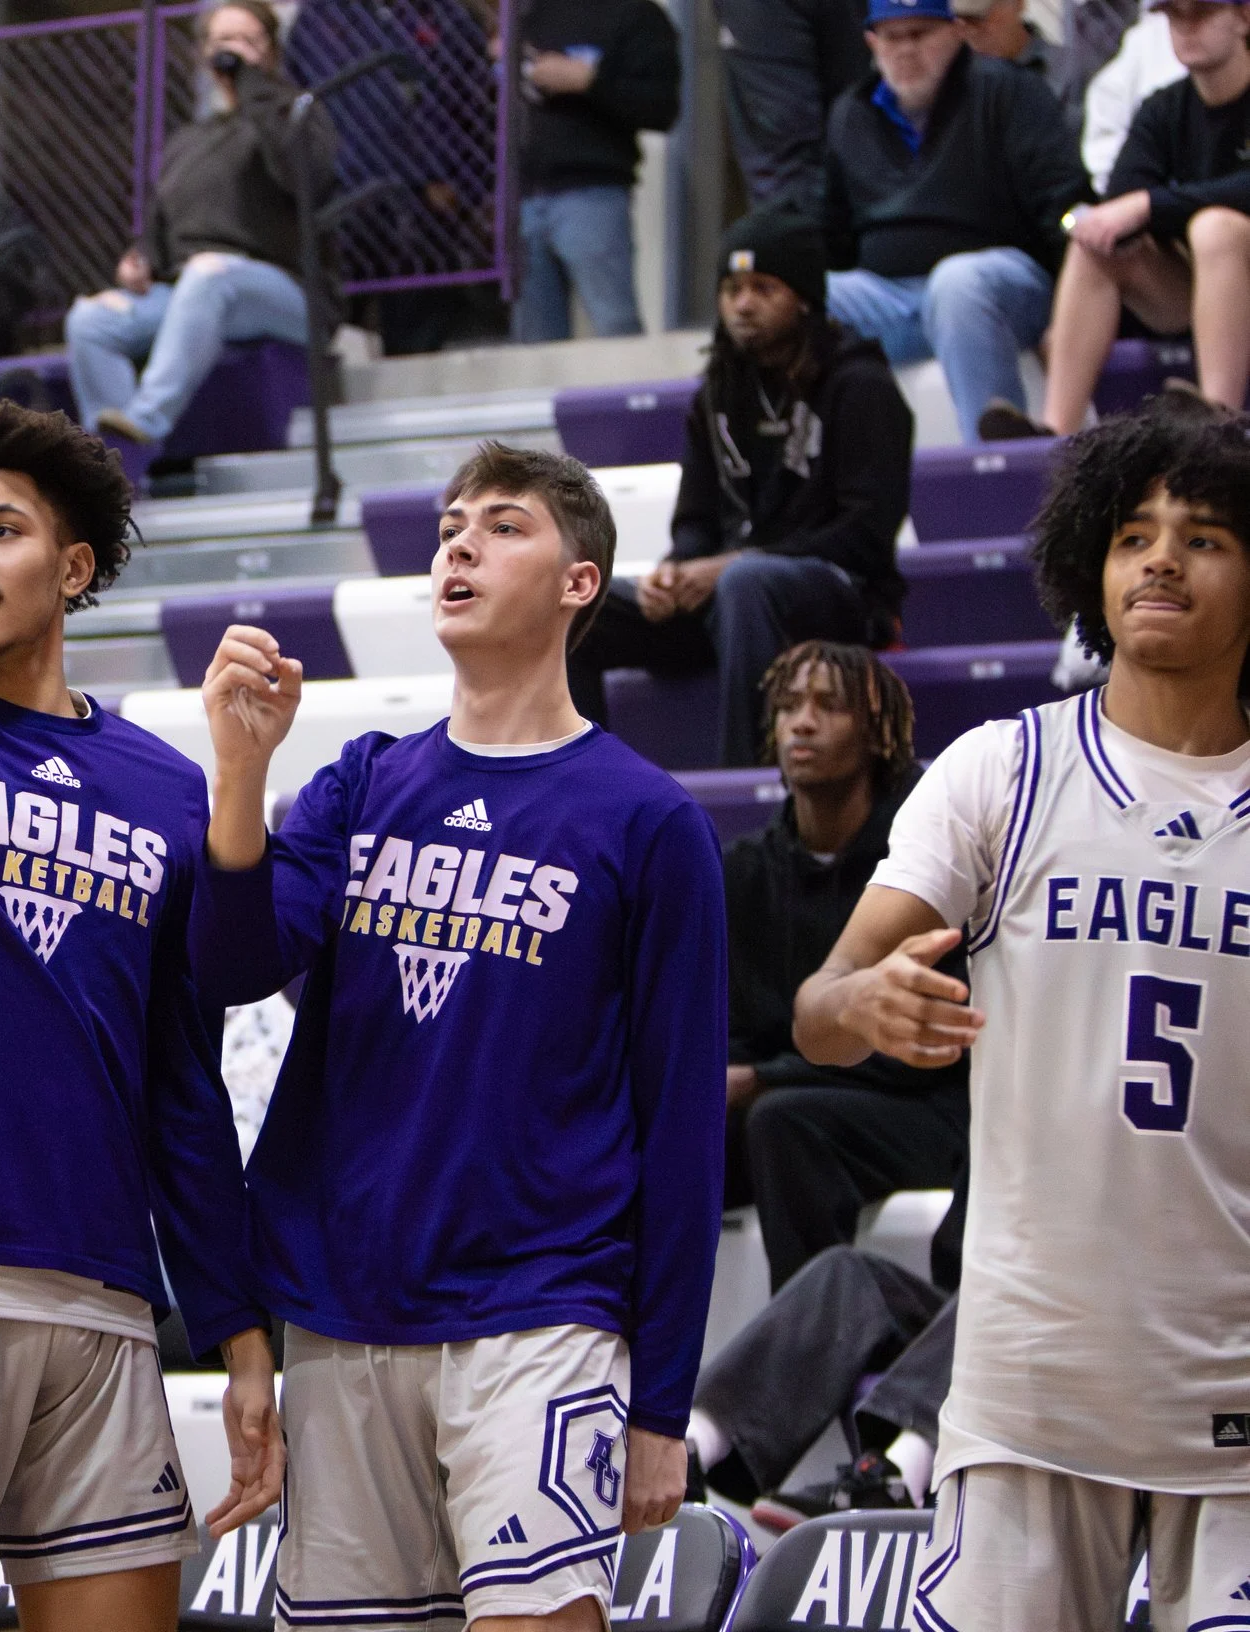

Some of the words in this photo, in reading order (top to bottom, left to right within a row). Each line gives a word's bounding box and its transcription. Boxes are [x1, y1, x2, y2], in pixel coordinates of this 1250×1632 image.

[31, 768, 81, 789] adidas
[443, 815, 493, 832] adidas
[345, 834, 579, 933] EAGLES
[340, 900, 543, 966] ASKETBALL
[1119, 970, 1208, 1136] 5
[190, 1524, 279, 1617] AV
